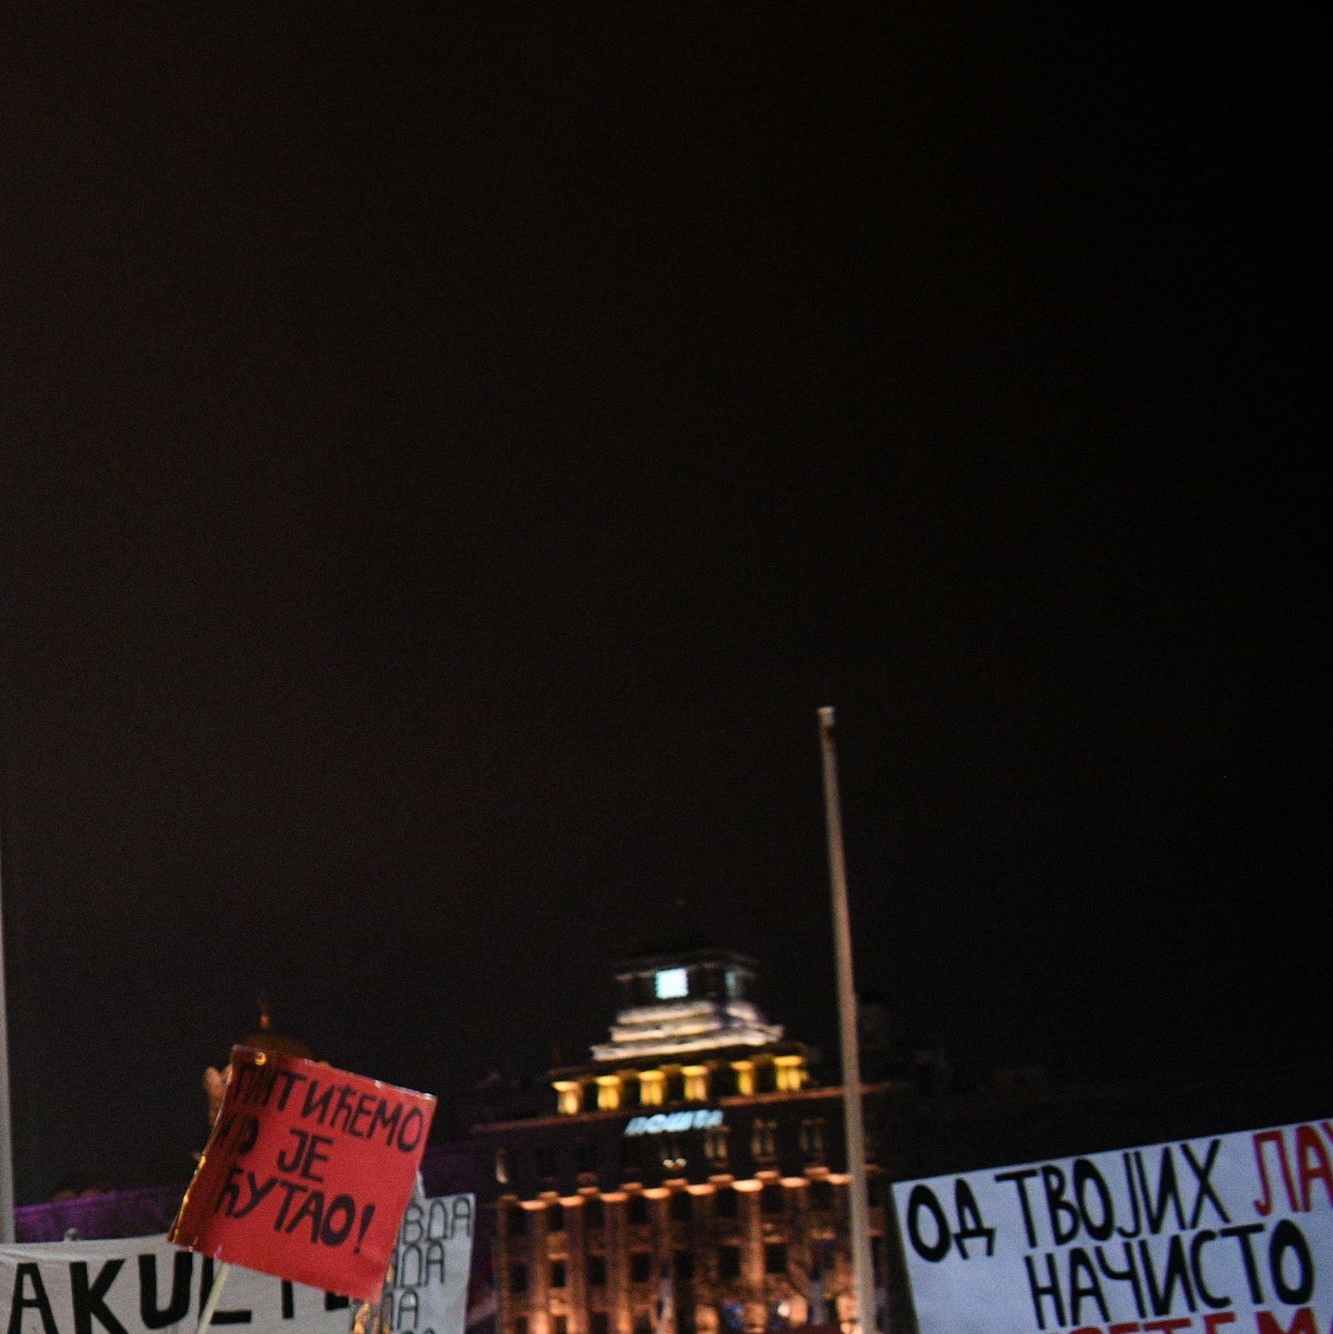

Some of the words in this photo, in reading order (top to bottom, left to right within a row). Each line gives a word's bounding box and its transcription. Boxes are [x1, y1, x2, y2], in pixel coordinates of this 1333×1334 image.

[232, 1064, 424, 1152] ПТИЋЕМО
[277, 1127, 333, 1183] ЈЕ
[906, 1177, 996, 1263] ОД
[994, 1137, 1230, 1249] ТВОЈИХ
[1252, 1120, 1333, 1217] ЛА
[214, 1165, 376, 1254] ЋУТАО!
[1023, 1219, 1315, 1331] НАЧИСТО
